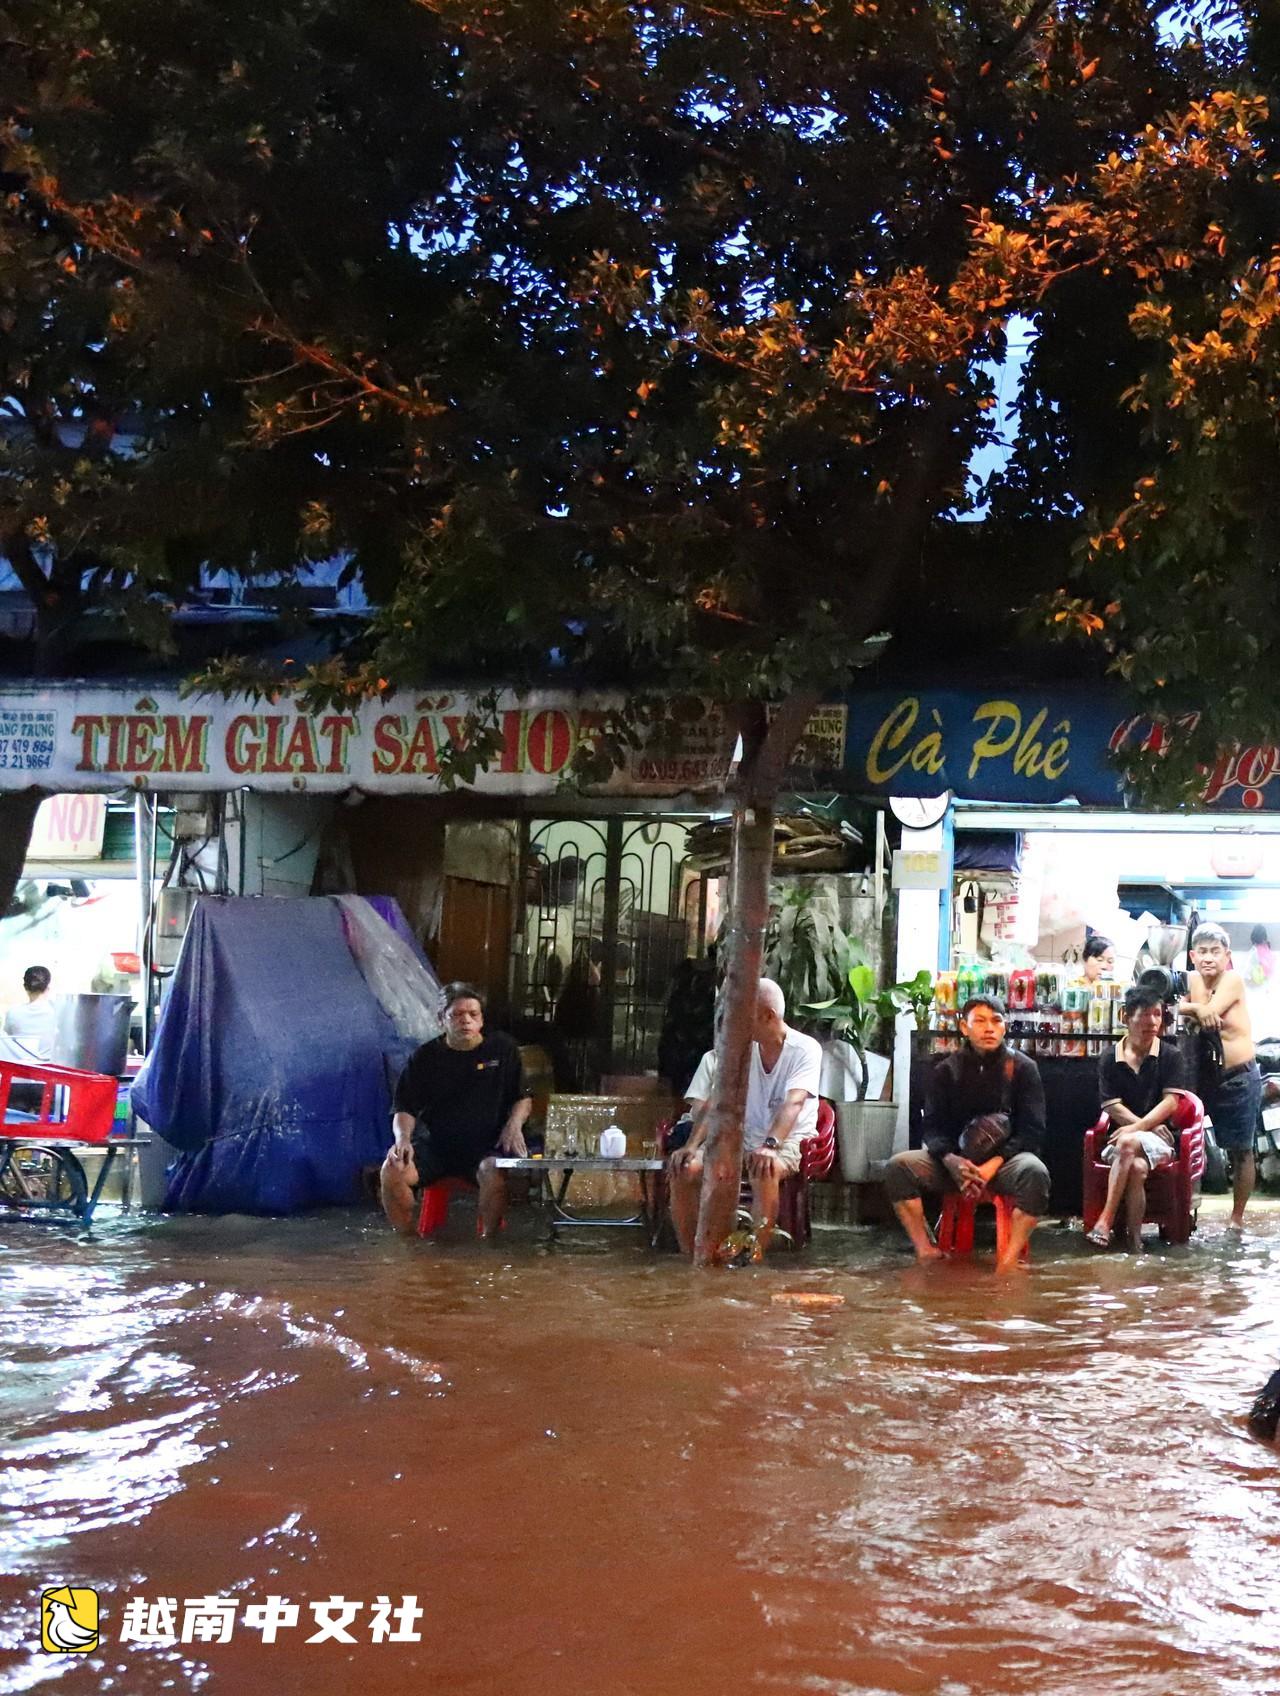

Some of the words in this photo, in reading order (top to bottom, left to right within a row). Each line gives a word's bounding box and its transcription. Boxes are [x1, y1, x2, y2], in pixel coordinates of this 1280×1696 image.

[71, 696, 213, 790] TIỆM
[865, 697, 947, 785] Cà
[969, 700, 1070, 781] Phê
